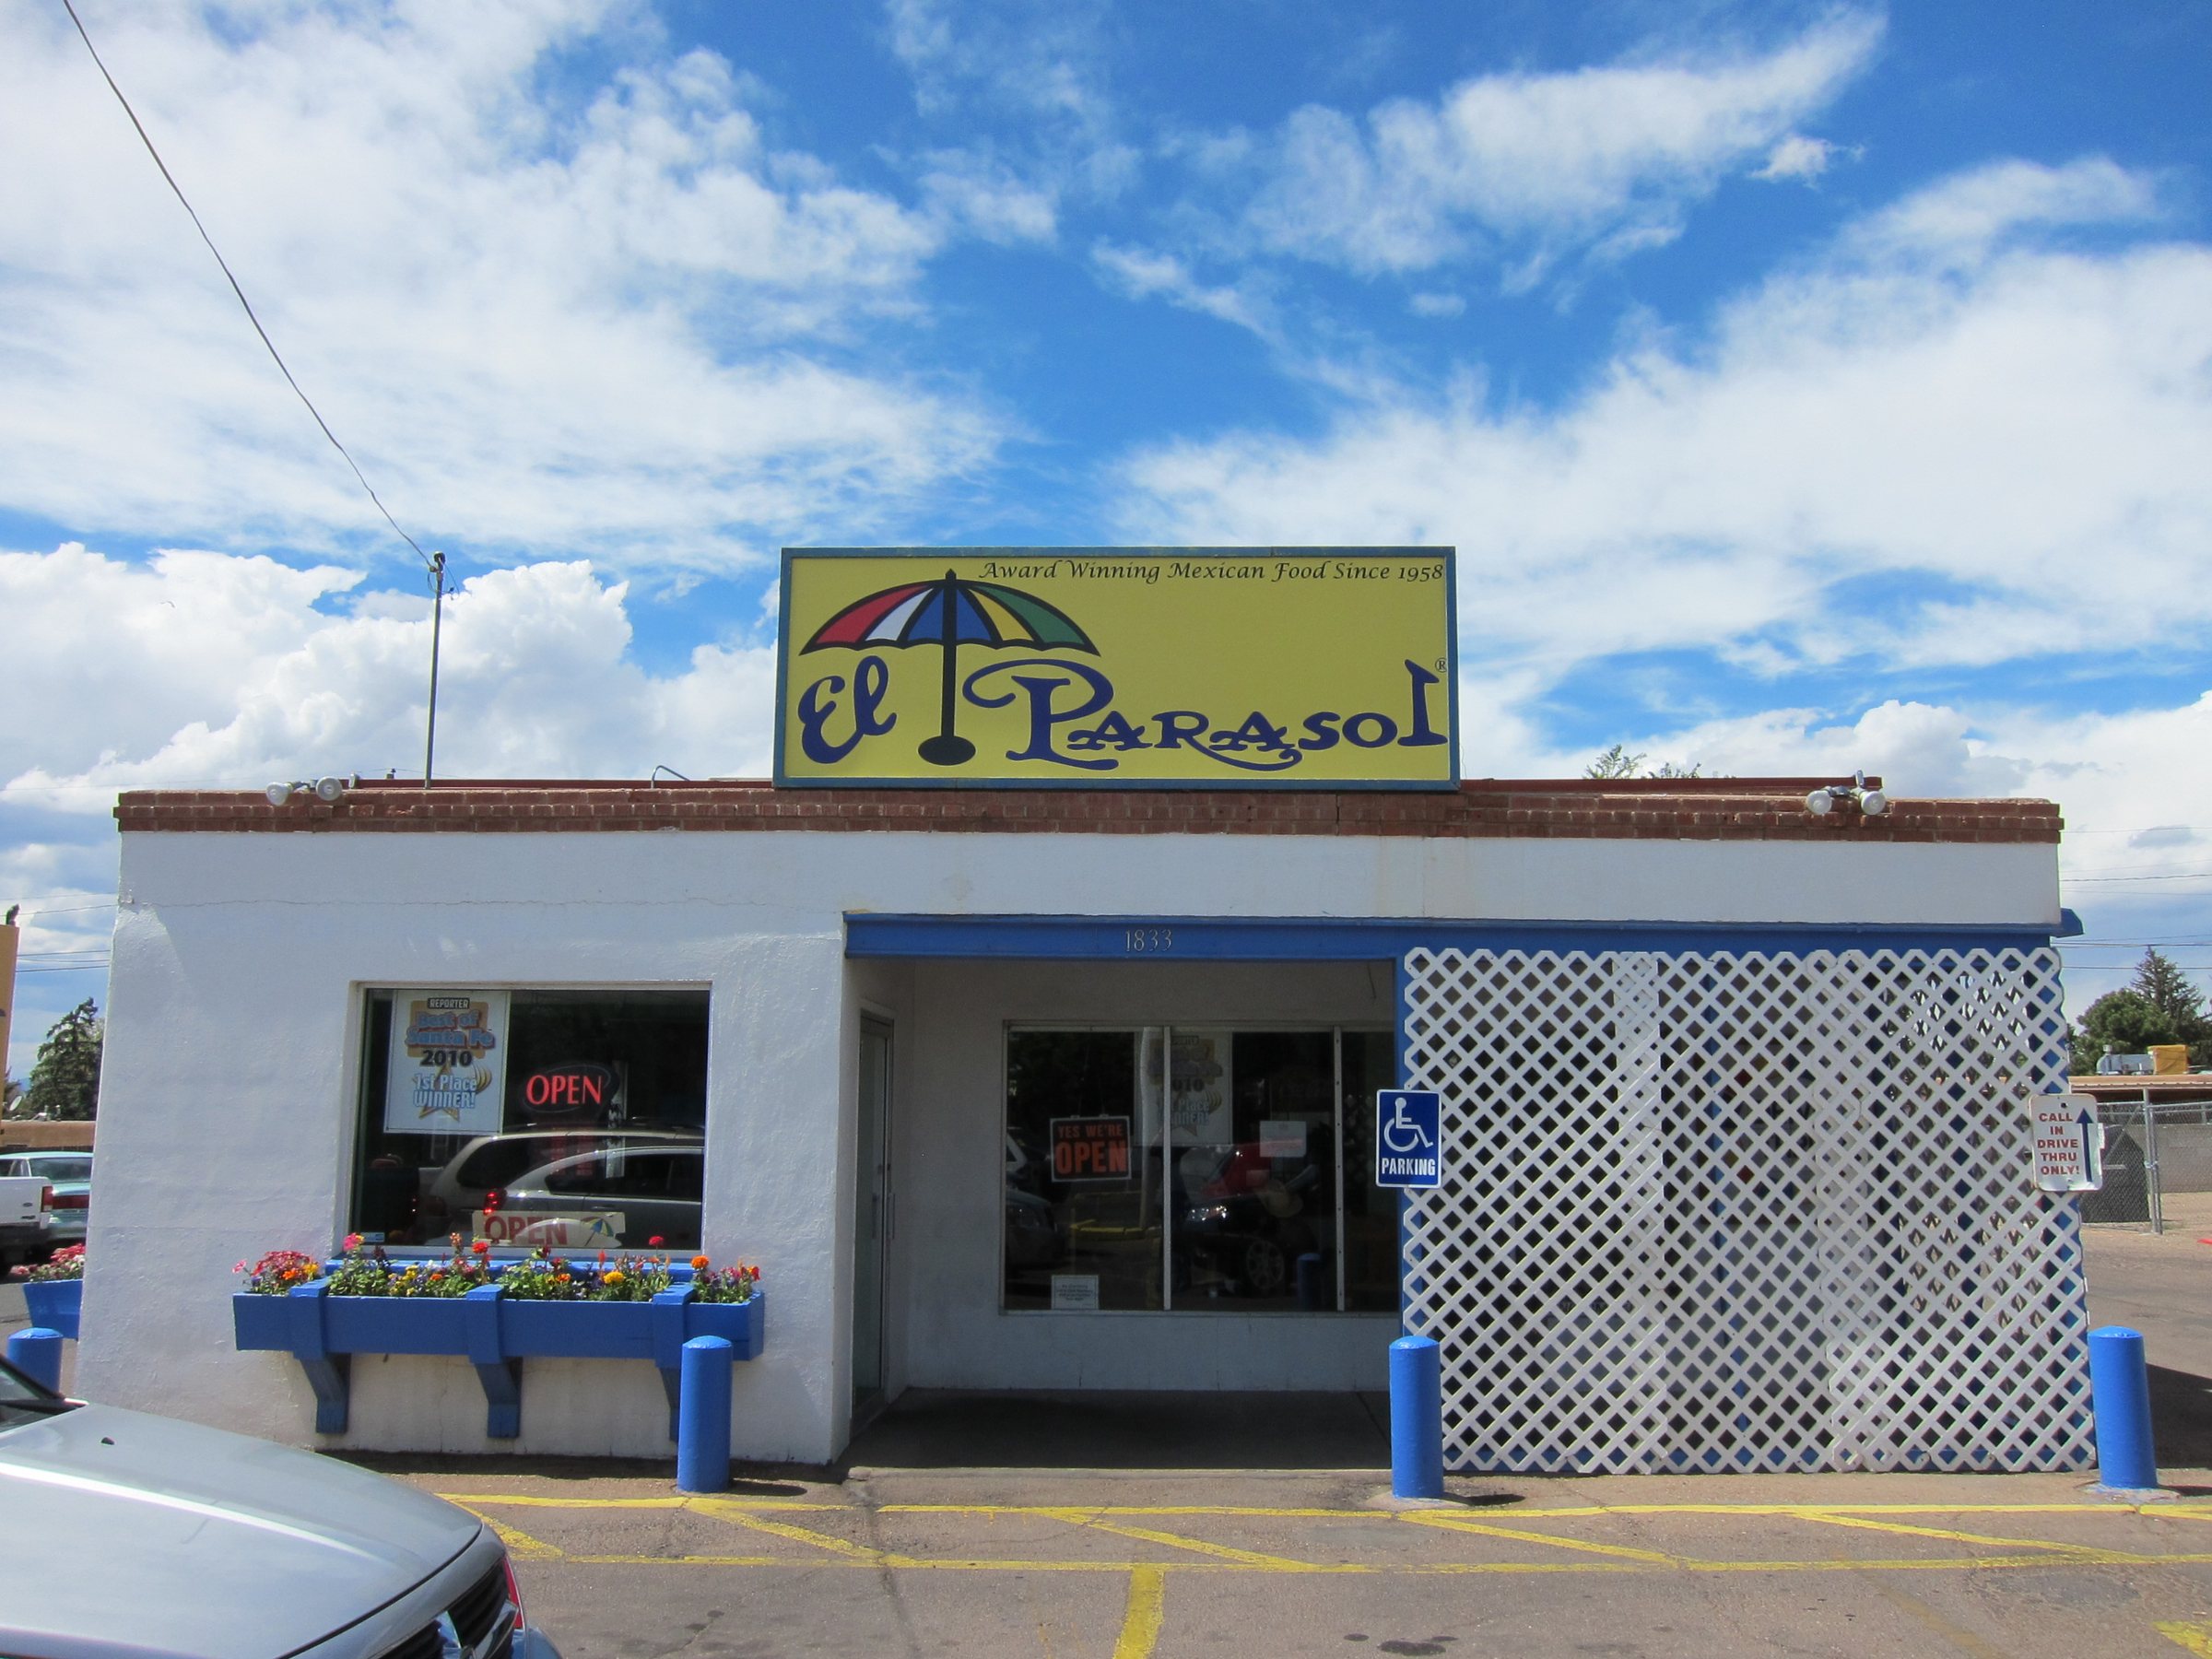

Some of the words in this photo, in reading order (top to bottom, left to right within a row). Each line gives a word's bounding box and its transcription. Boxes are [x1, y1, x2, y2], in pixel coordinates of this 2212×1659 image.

[979, 560, 1062, 579] Award
[1066, 560, 1159, 584] Winning
[1167, 561, 1265, 579] Mexican
[1272, 560, 1331, 582] Food
[1334, 561, 1390, 579] Since
[1398, 563, 1444, 582] 1958
[797, 655, 898, 764] El
[1125, 929, 1171, 952] 1833
[429, 998, 469, 1008] REPORTER
[416, 1011, 456, 1030] Best
[406, 1026, 466, 1048] Santa
[468, 1028, 495, 1048] Fe
[419, 1050, 472, 1066] 2010
[415, 1073, 435, 1089] 1st
[440, 1074, 477, 1091] Place
[526, 1075, 603, 1105] OPEN
[1171, 1077, 1205, 1093] 010
[2039, 1112, 2073, 1123] CALL
[1058, 1125, 1080, 1138] YES
[1086, 1124, 1123, 1136] WE'RE
[2050, 1126, 2064, 1135] IN
[2037, 1139, 2078, 1148] DRIVE
[1055, 1141, 1126, 1174] OPEN
[2041, 1152, 2077, 1161] THRU
[1382, 1158, 1436, 1176] PARKING
[2041, 1165, 2080, 1175] ONLY!
[484, 1216, 568, 1245] OPEN
